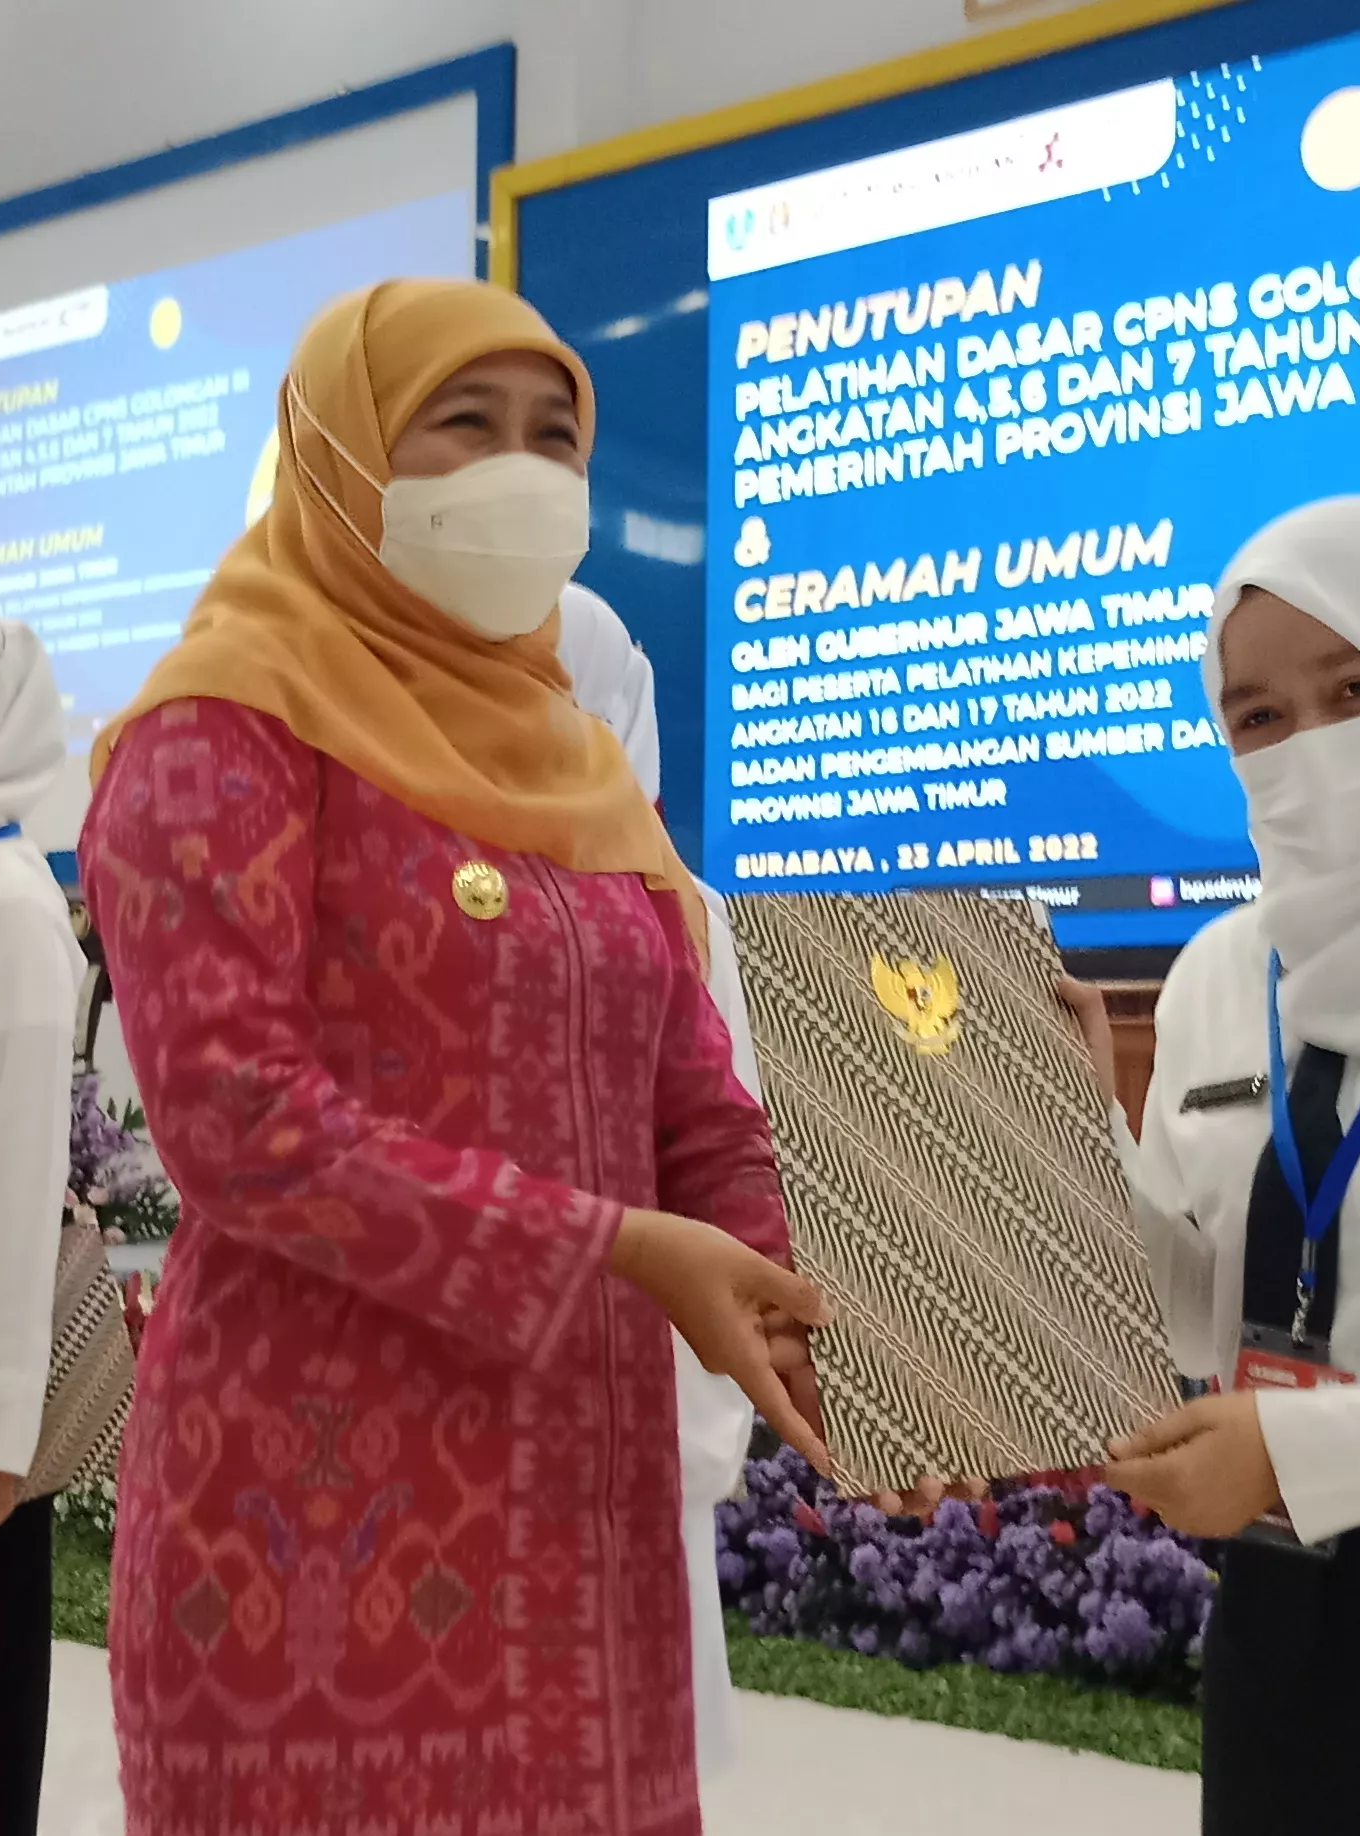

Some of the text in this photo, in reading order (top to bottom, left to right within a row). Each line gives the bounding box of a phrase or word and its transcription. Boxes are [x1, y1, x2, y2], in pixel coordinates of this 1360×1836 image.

[736, 258, 1042, 369] PENUTUPAN
[735, 343, 945, 421] PELATIHAN
[957, 310, 1103, 378] DASAR
[1114, 282, 1238, 346] CPNS
[734, 388, 944, 465] ANGKATAN
[954, 370, 1047, 424] 4,5,6
[1057, 348, 1153, 406] DAN
[1166, 339, 1196, 386] 7
[735, 429, 983, 508] PEMERINTAH
[995, 388, 1201, 464] PROVINSI
[1214, 363, 1356, 427] JAWA
[39, 523, 104, 556] UMUM
[734, 516, 771, 567] &
[734, 517, 1173, 623] CERAMAH UMUM
[731, 634, 810, 672] OLEH
[816, 612, 988, 663] GUBERNUR
[995, 598, 1095, 642] JAWA
[1101, 583, 1215, 628] TIMUR
[731, 678, 1173, 749] ANGKATAN 16 DAN 17 TAHUN 2022
[732, 679, 788, 711] BAGI
[793, 667, 901, 705] PESERTA
[907, 648, 1052, 693] PELATIHAN
[731, 754, 815, 787] BADAN
[821, 732, 1039, 779] PENGEMBANGAN
[1046, 722, 1164, 759] SUMBER
[731, 778, 1007, 825] PROVINSI JAWA TIMUR
[735, 846, 874, 879] SURABAYA
[936, 837, 1021, 868] APRIL
[1028, 832, 1098, 862] 2022
